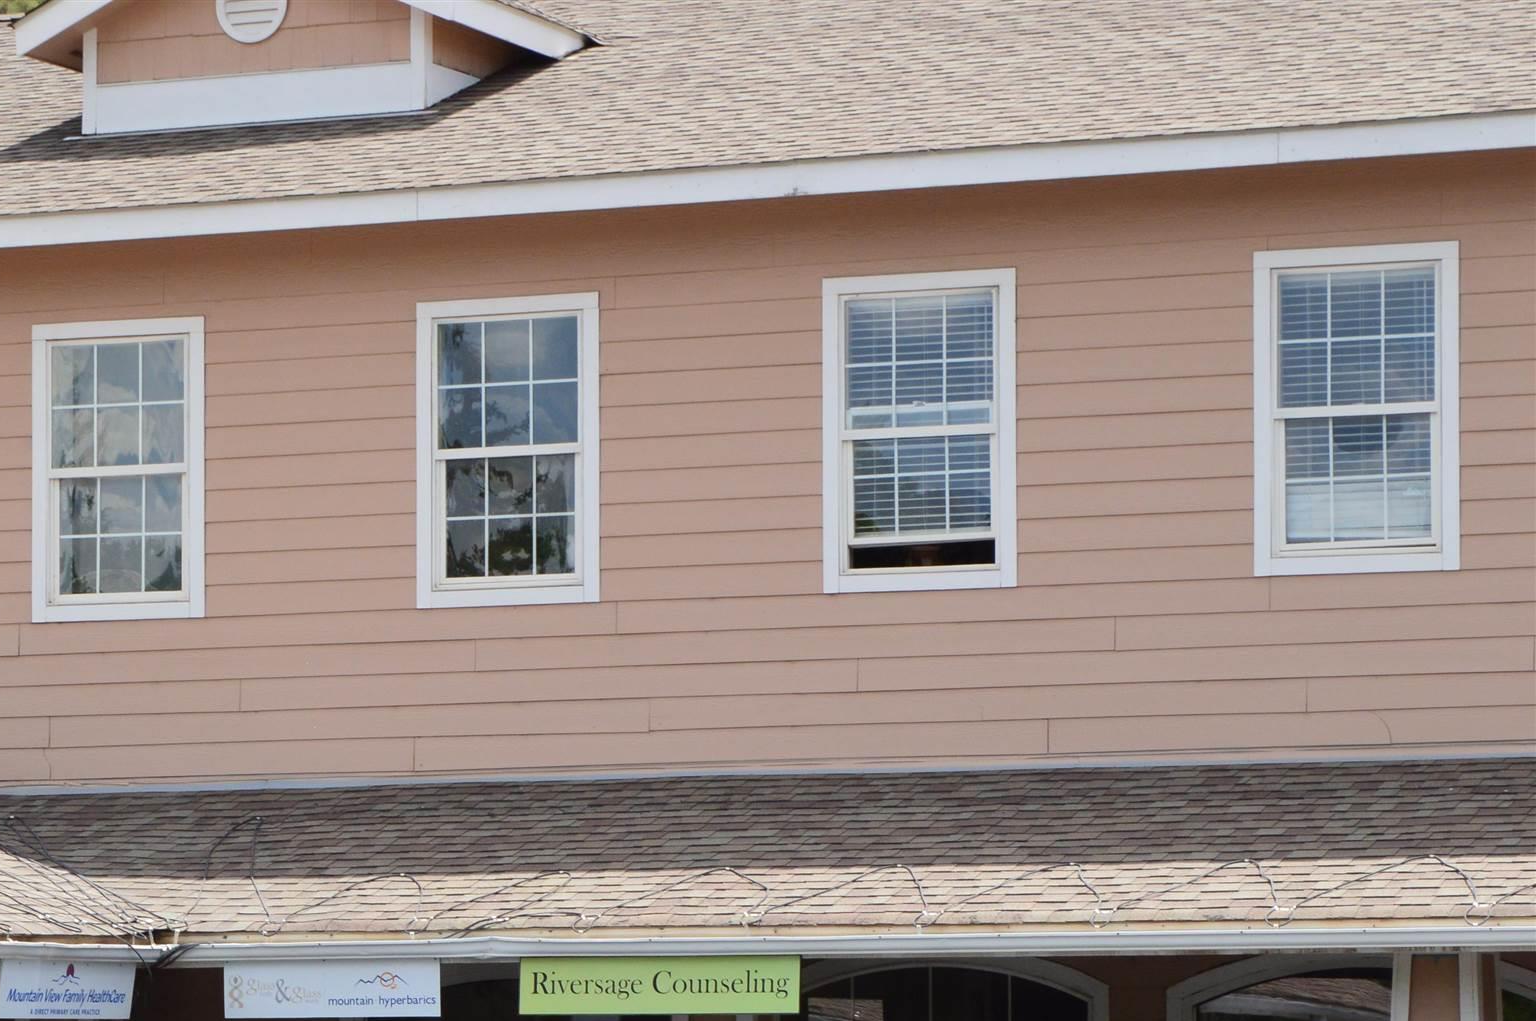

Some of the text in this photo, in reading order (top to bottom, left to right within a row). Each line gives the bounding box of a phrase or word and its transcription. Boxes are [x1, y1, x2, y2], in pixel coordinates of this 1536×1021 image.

[530, 970, 790, 1000] Riversage Counseling
[7, 988, 126, 1007] Mountain View Family HealthCare
[327, 994, 437, 1008] mountain hyperbarics
